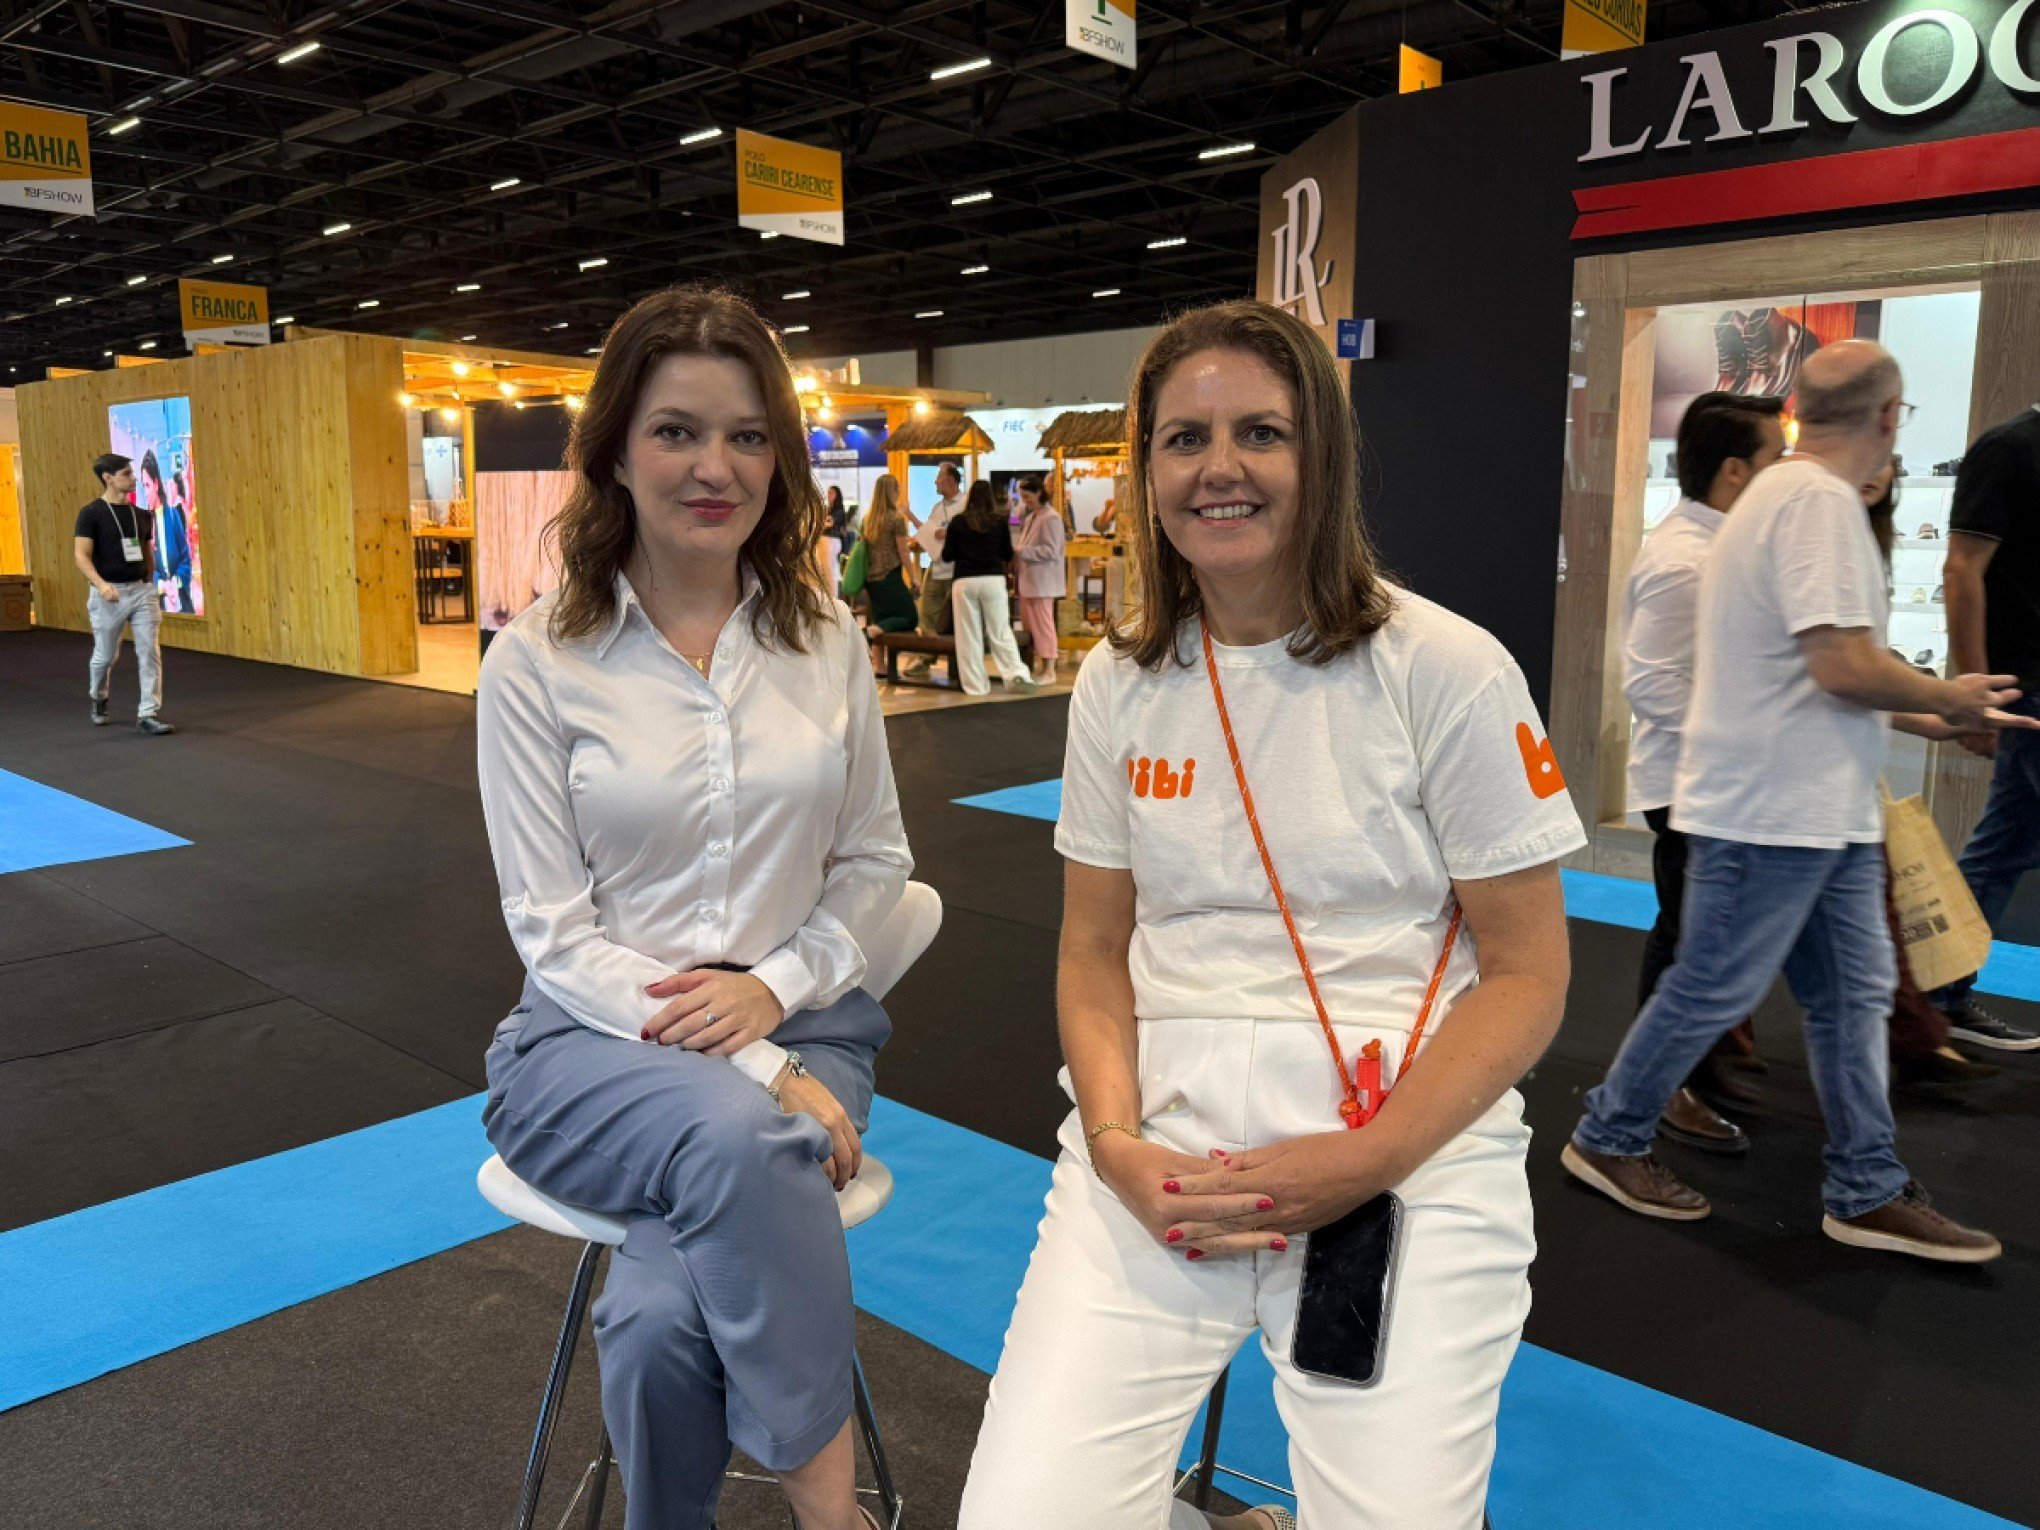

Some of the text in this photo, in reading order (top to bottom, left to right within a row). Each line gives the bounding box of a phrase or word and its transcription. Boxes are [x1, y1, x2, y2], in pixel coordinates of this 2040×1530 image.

[4, 130, 82, 169] BAHIA
[781, 168, 834, 197] CEARENSE
[191, 295, 258, 321] FRANCA
